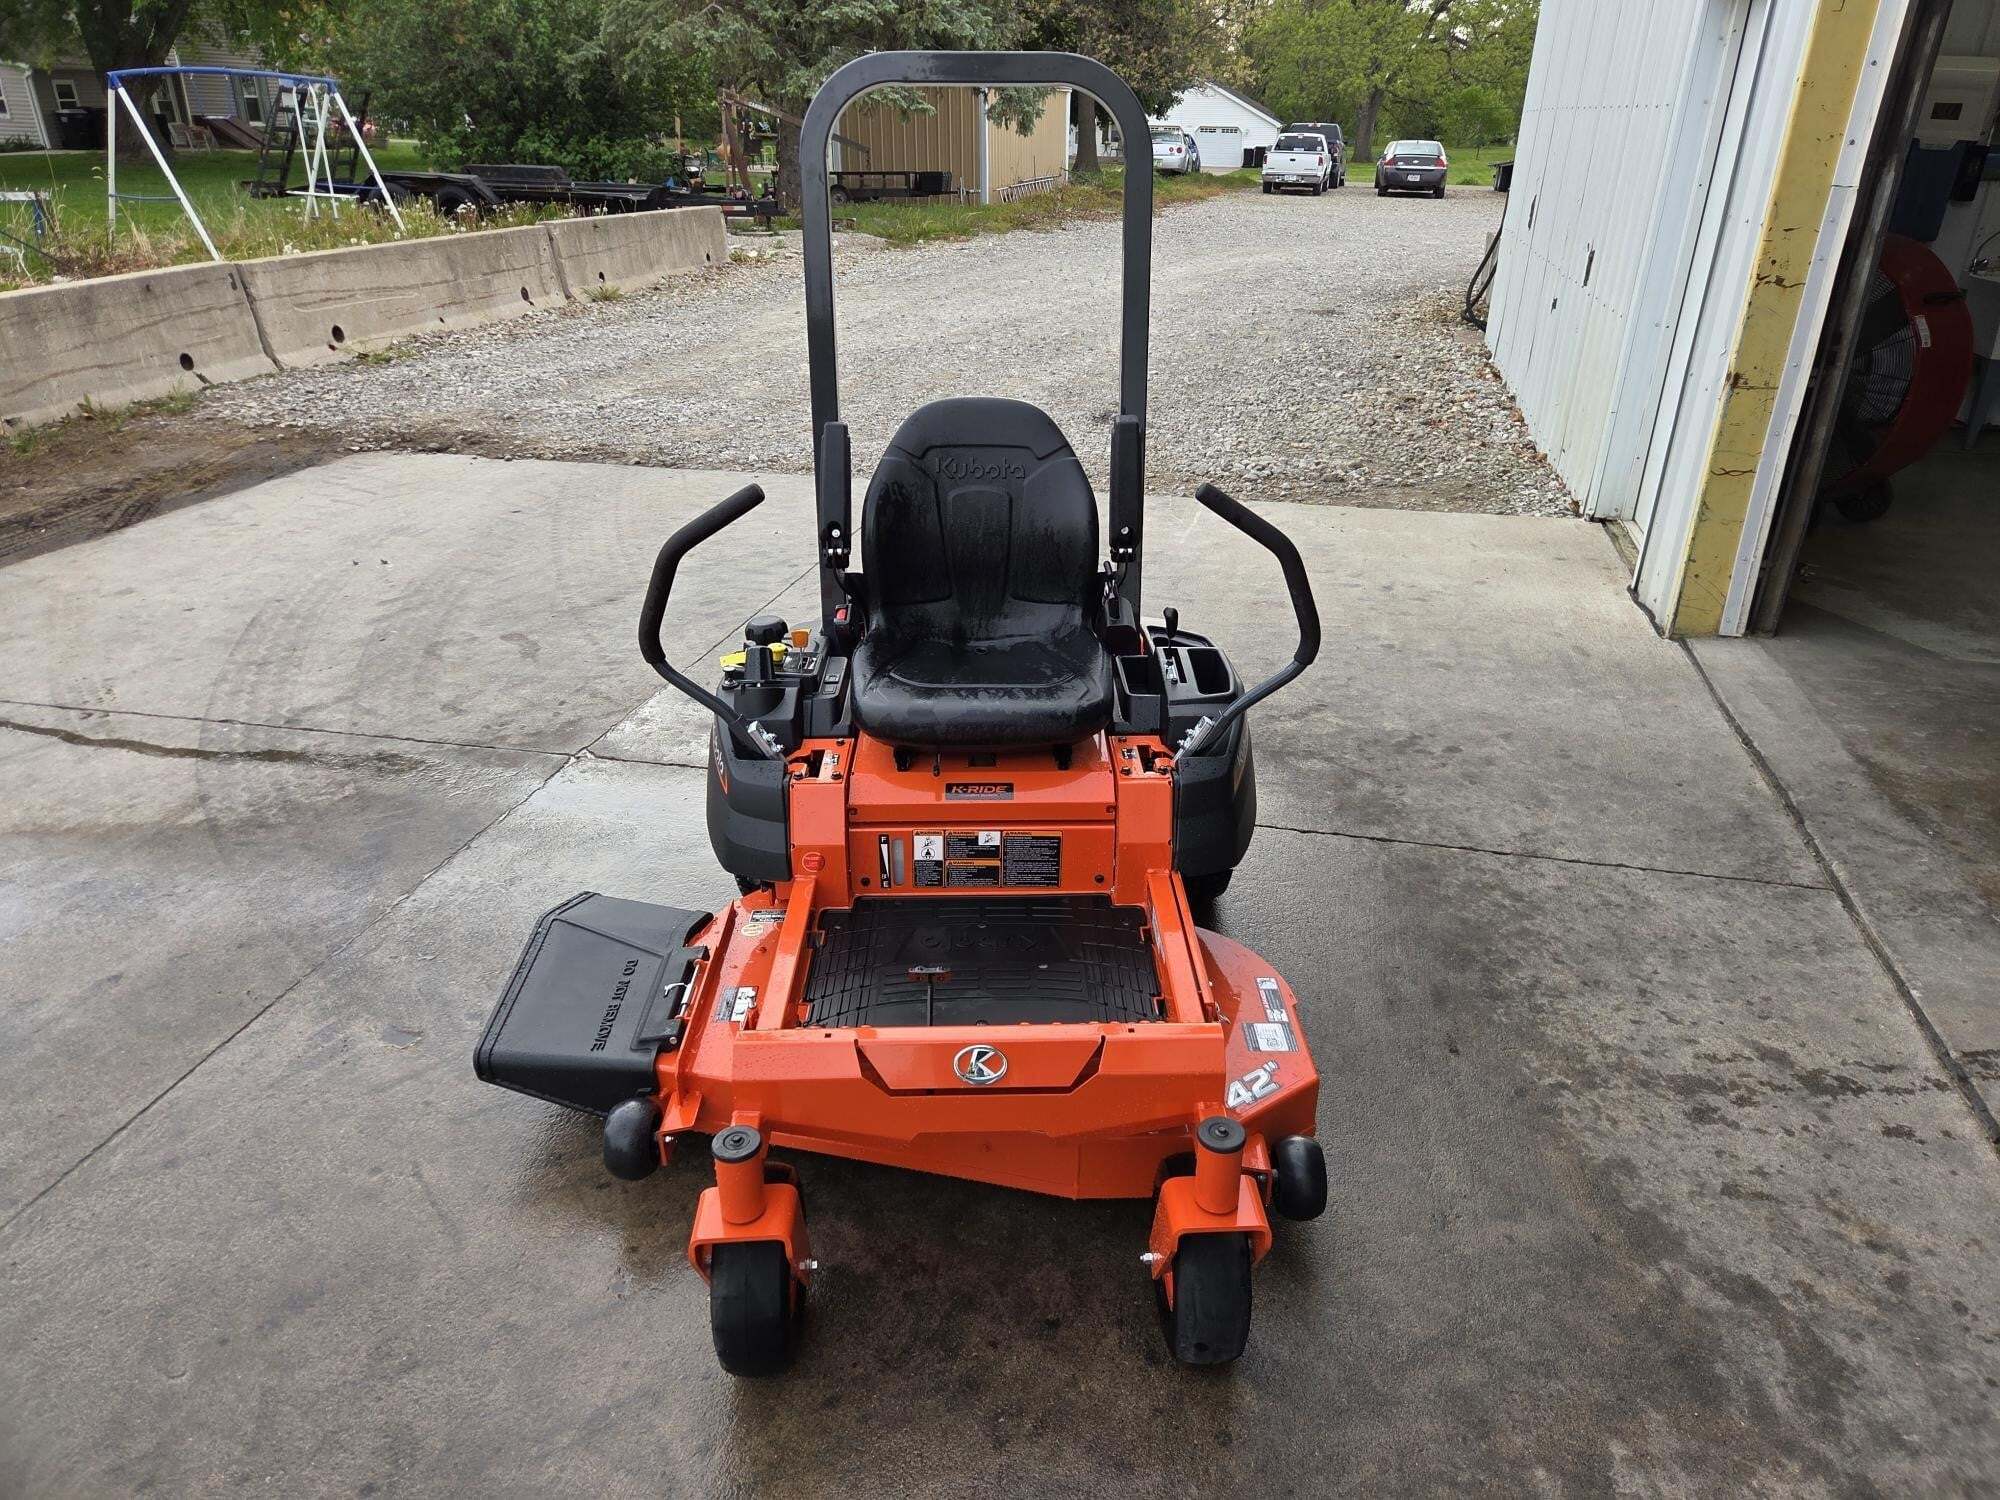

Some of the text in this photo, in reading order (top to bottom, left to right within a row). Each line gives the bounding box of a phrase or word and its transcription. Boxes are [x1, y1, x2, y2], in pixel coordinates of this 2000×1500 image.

[935, 456, 1026, 480] Kubota
[951, 785, 1008, 794] K-RIDE
[590, 959, 639, 1052] DO NOT REMOVE
[1226, 1059, 1281, 1109] 42"
